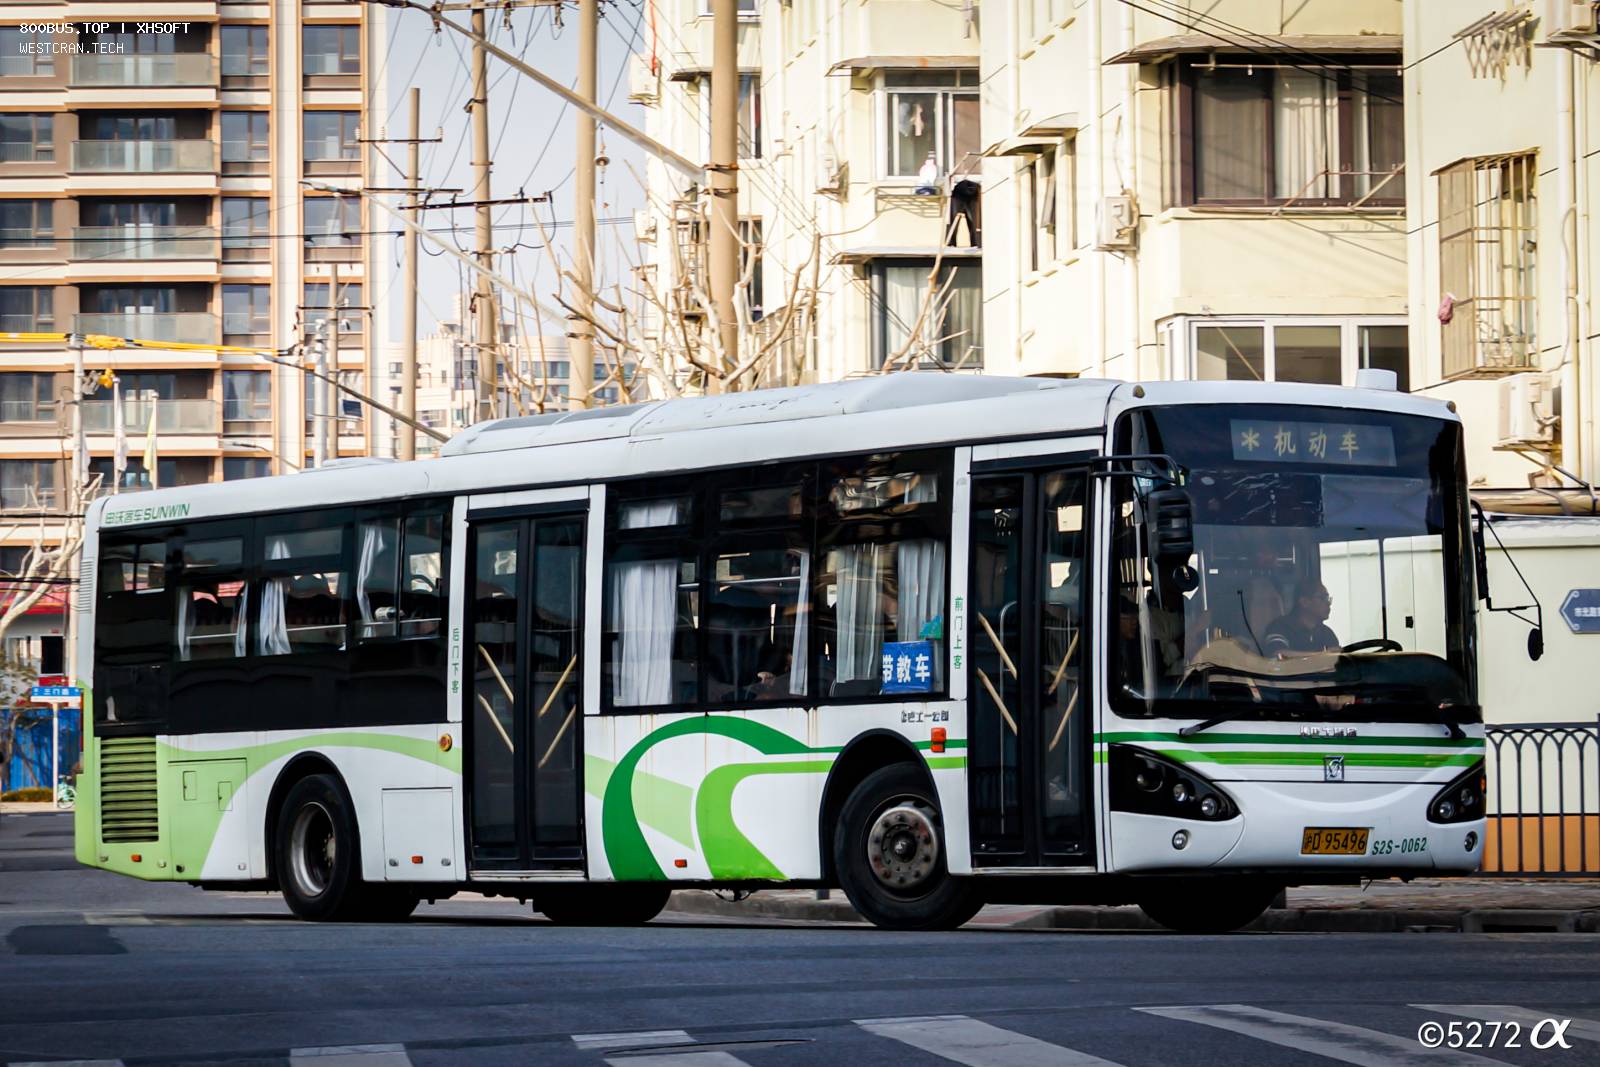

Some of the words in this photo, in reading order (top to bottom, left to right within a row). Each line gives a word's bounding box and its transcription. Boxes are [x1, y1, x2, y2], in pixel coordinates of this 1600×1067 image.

[953, 596, 963, 669] 前门上客
[451, 628, 460, 693] 后门下客
[882, 653, 931, 683] 带教车
[1371, 837, 1428, 856] S2S-0062
